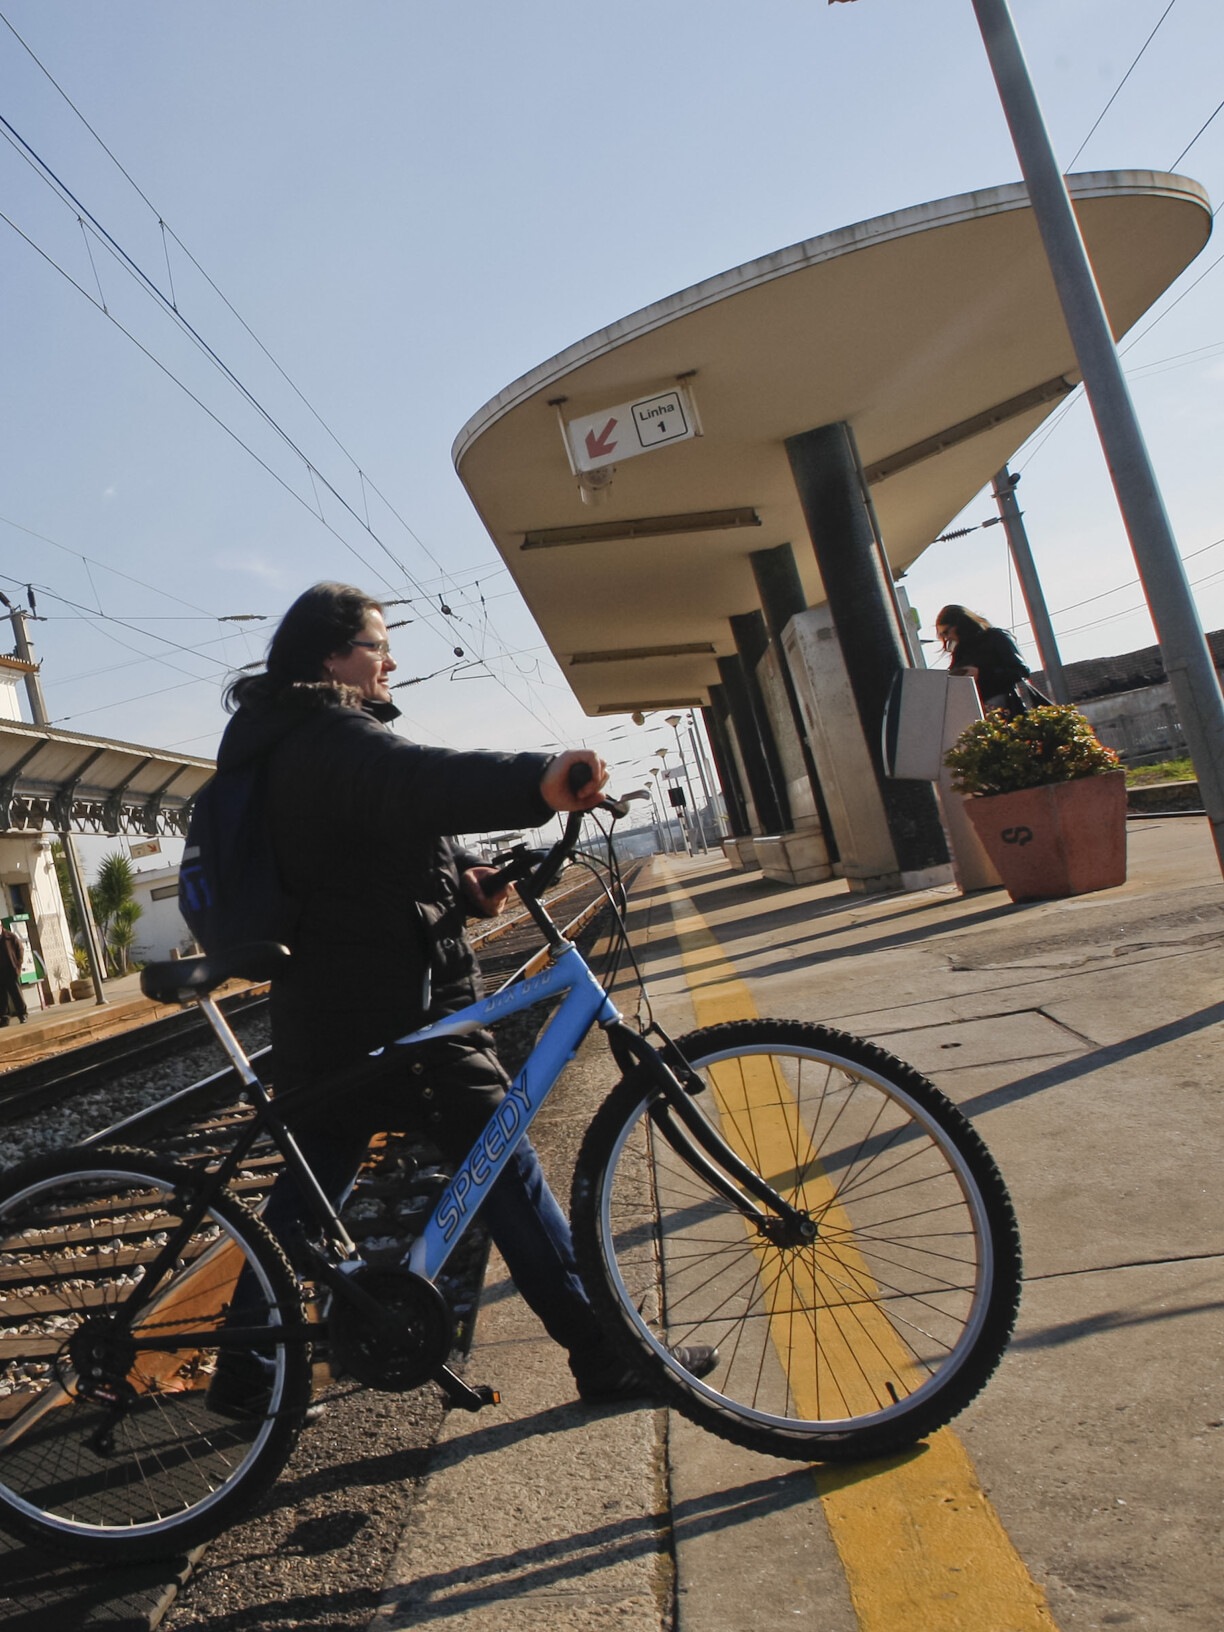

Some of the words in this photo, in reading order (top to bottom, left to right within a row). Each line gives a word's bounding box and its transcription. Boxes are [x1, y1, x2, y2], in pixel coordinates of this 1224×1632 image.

[639, 402, 675, 421] Linha
[657, 421, 667, 433] 1
[436, 1073, 533, 1243] SPEEDY
